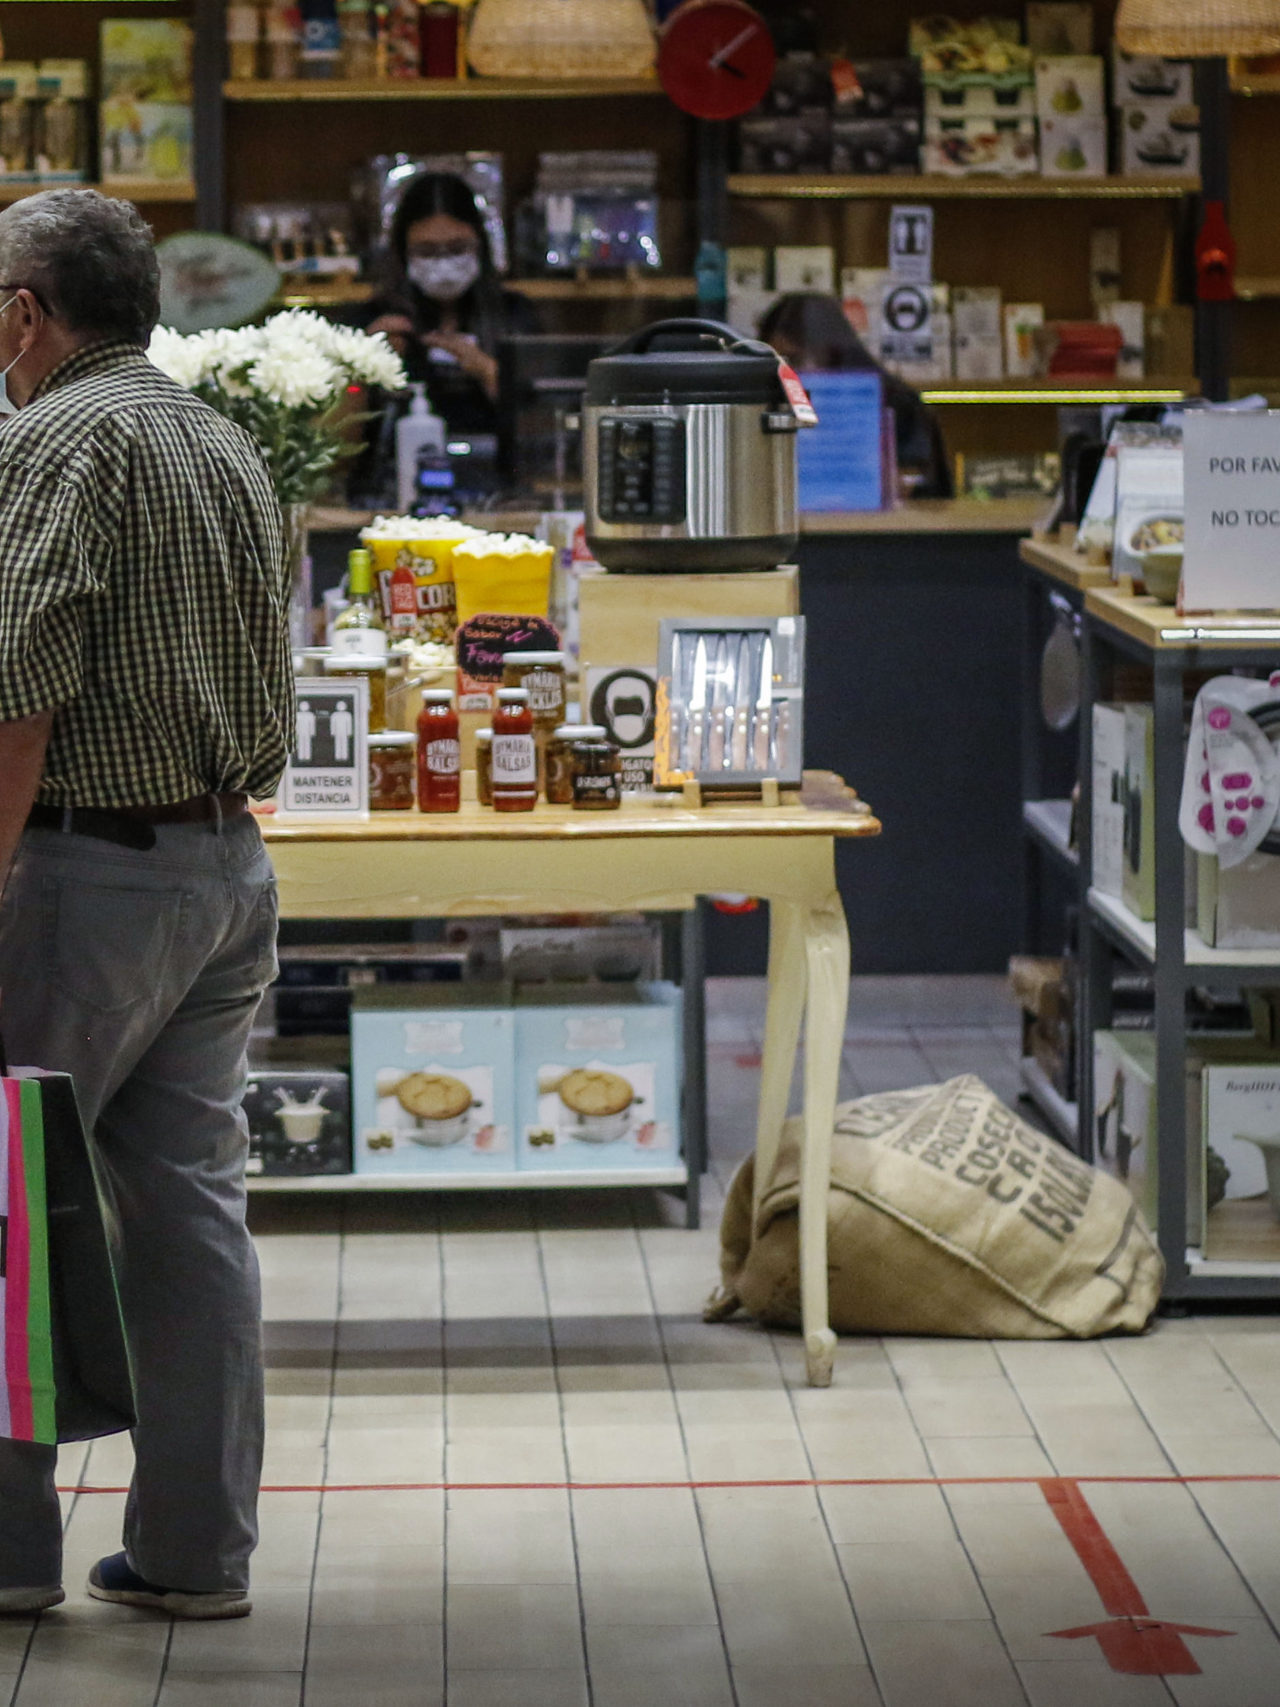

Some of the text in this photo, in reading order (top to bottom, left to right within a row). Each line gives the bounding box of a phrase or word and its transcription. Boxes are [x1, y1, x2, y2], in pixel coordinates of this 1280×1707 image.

[1210, 457, 1246, 473] POR
[1212, 510, 1280, 526] NO TOC
[293, 775, 352, 787] MANTENER
[624, 772, 645, 782] USO
[295, 792, 351, 804] DISTANCIA
